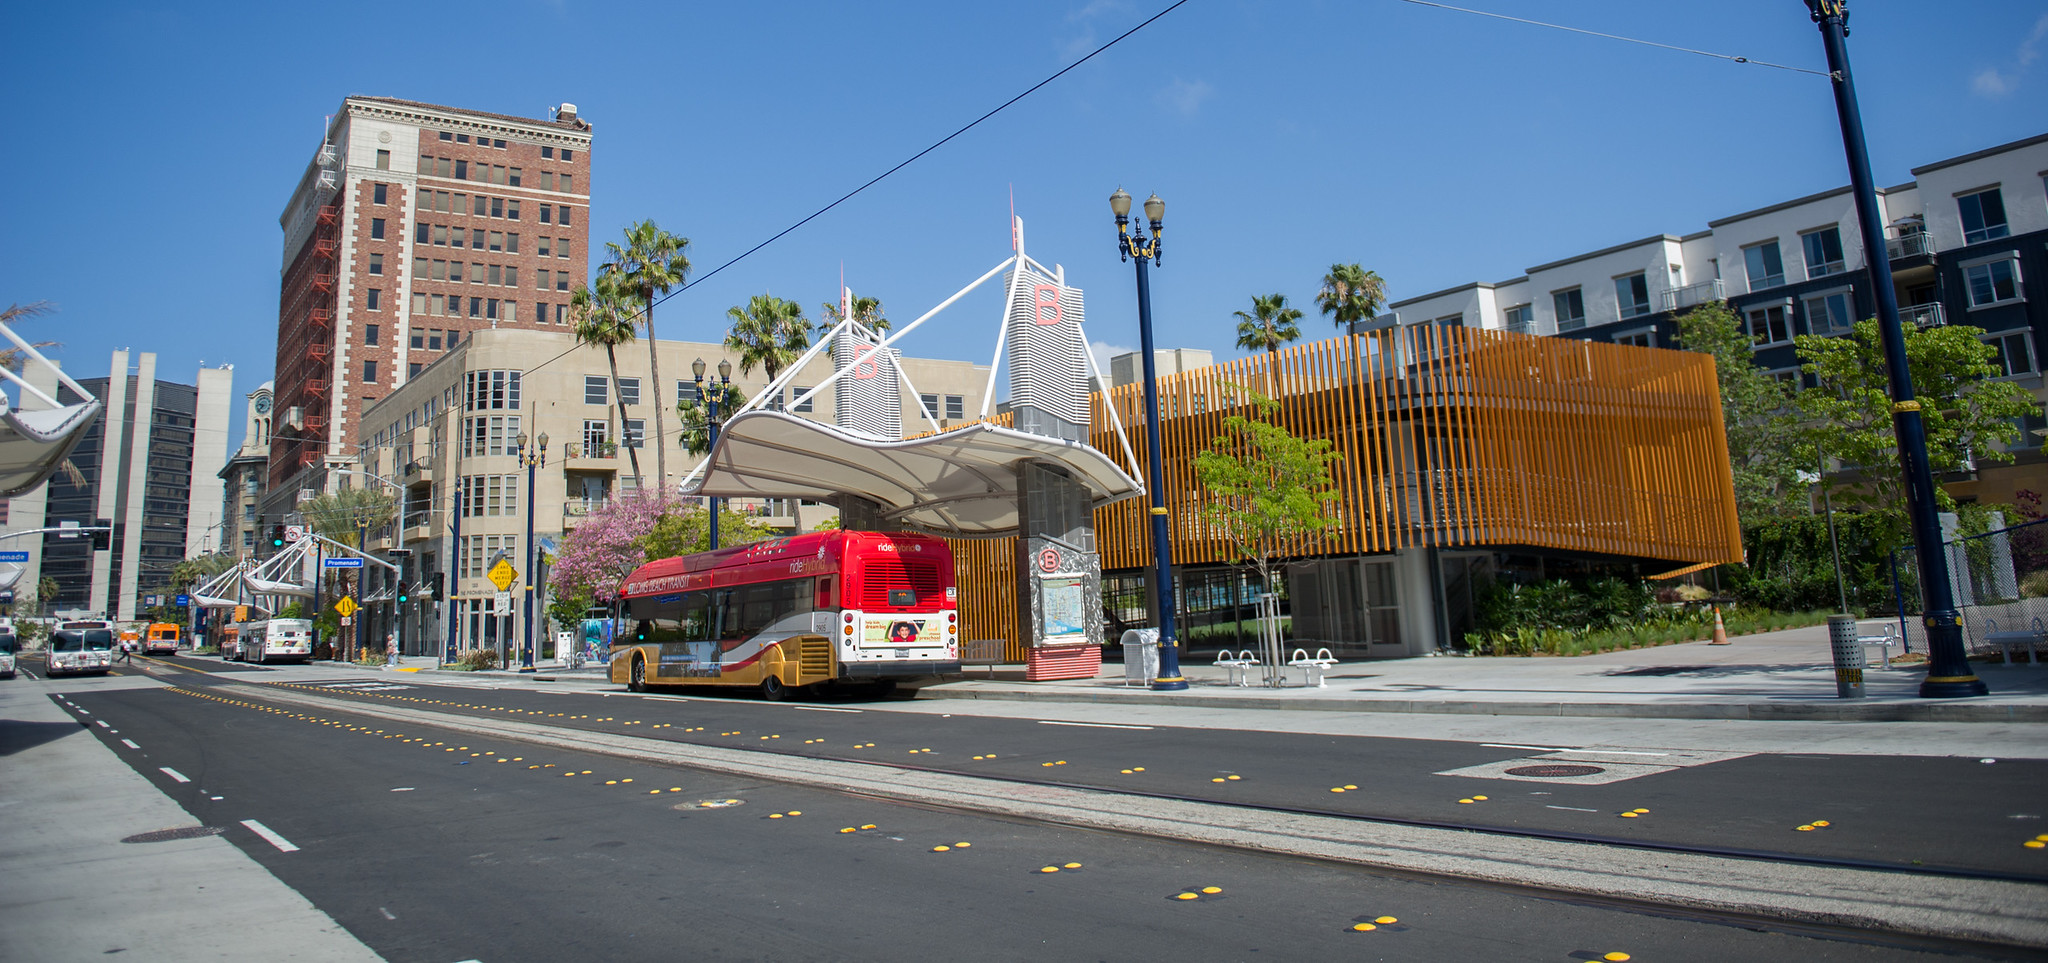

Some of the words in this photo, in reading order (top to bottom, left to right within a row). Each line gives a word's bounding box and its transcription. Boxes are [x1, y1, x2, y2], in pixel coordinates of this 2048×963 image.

[1034, 284, 1062, 326] B
[854, 344, 878, 380] B
[878, 543, 915, 552] rideHybrid
[789, 557, 826, 574] rideHybrid
[1044, 553, 1057, 569] B
[633, 581, 649, 594] LONG
[649, 578, 667, 592] BEACH
[667, 575, 690, 590] TRANSIT
[816, 624, 826, 632] 2905
